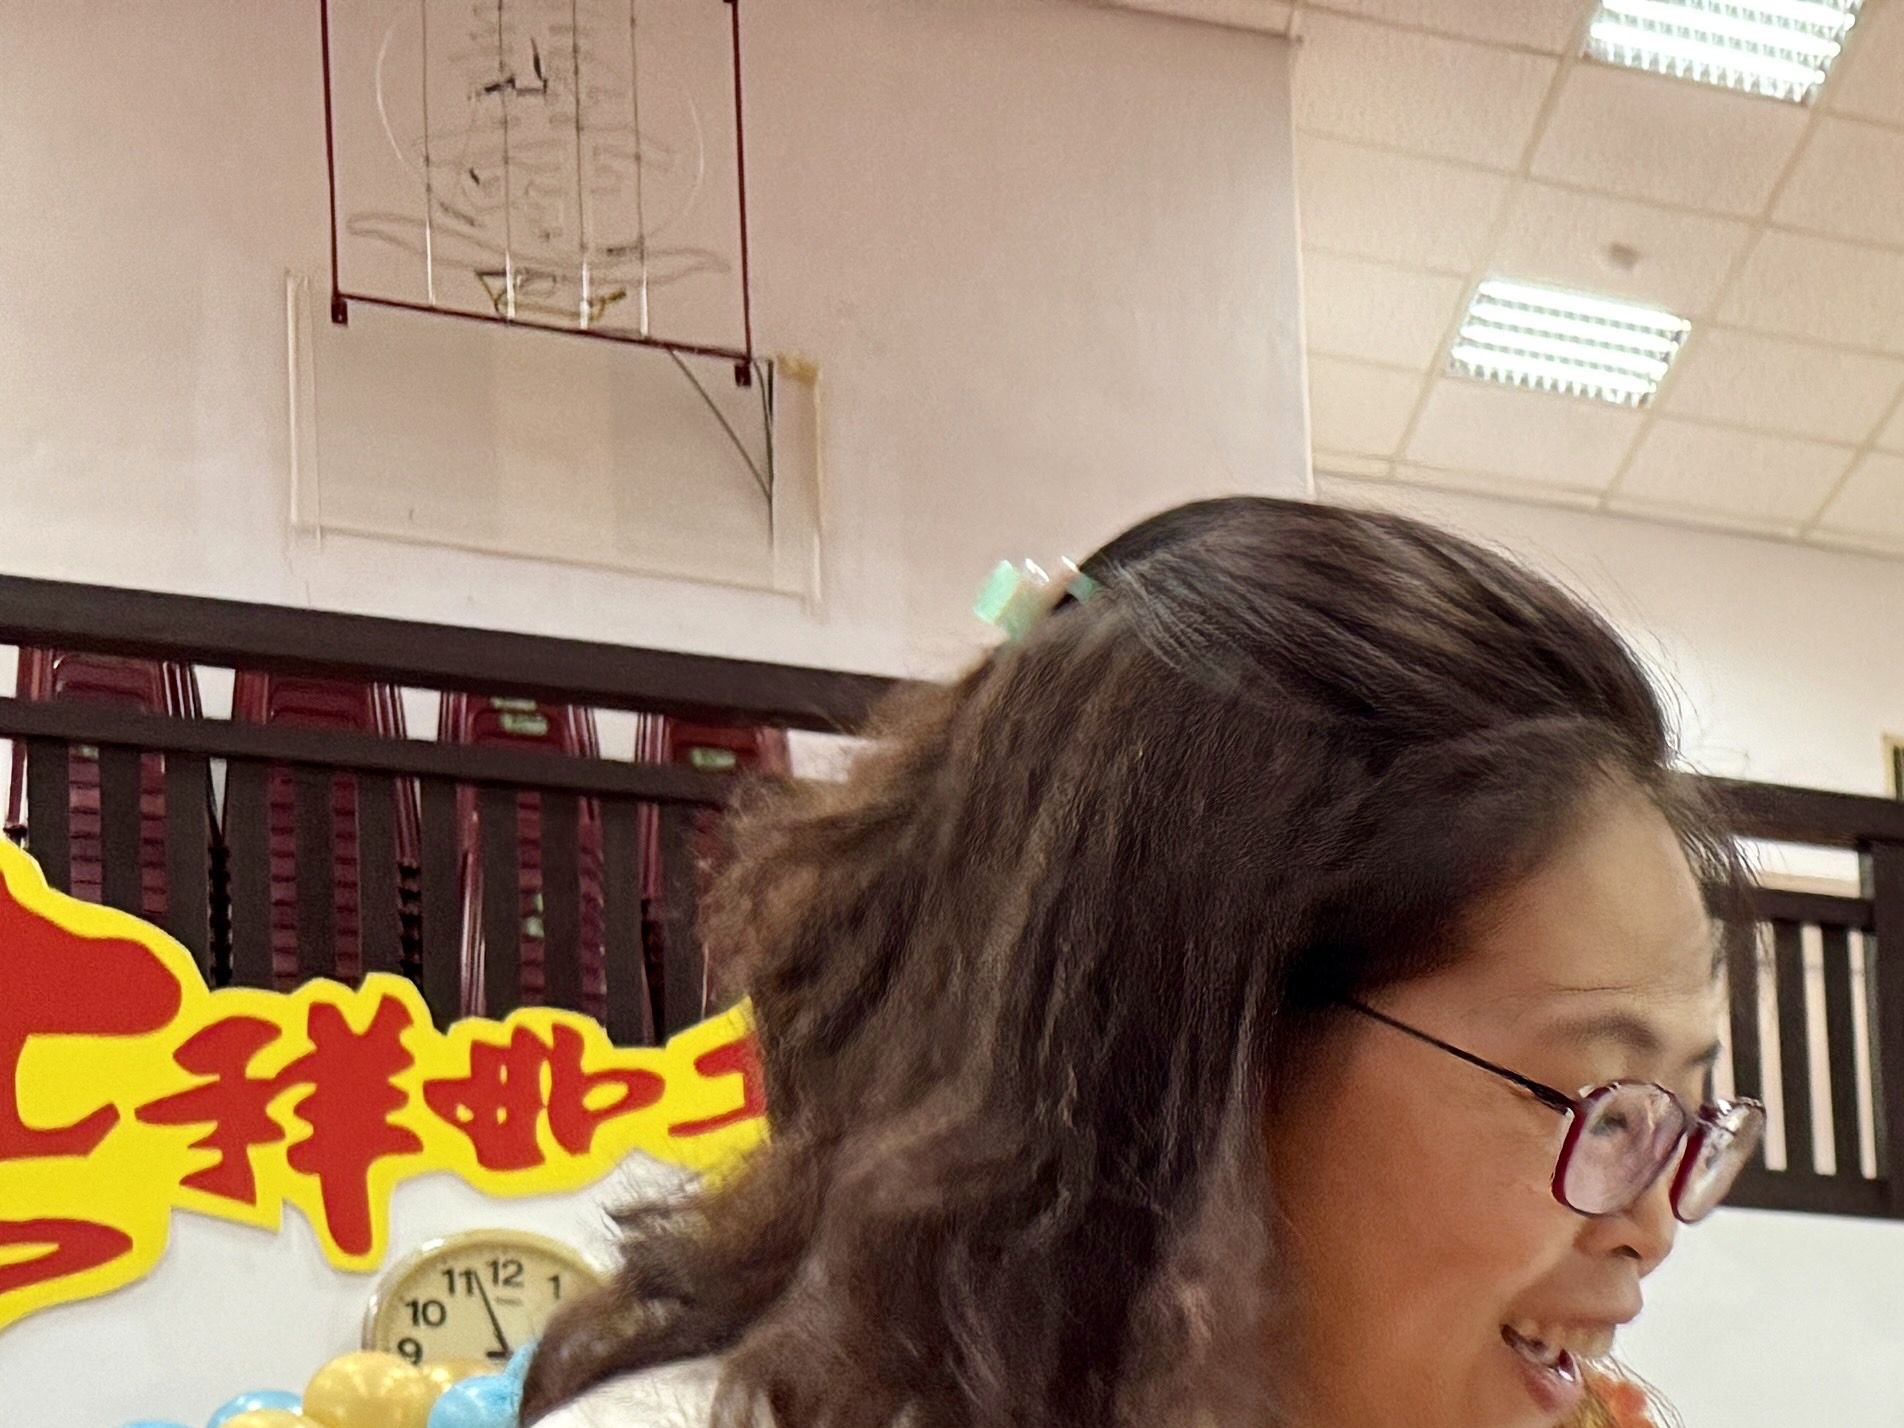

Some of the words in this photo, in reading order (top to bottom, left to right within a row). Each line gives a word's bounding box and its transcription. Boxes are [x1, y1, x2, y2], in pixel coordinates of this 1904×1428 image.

[442, 1266, 475, 1297] 11
[486, 1258, 525, 1288] 12
[548, 1274, 562, 1300] 1
[405, 1299, 447, 1328] 10
[397, 1337, 423, 1366] 9
